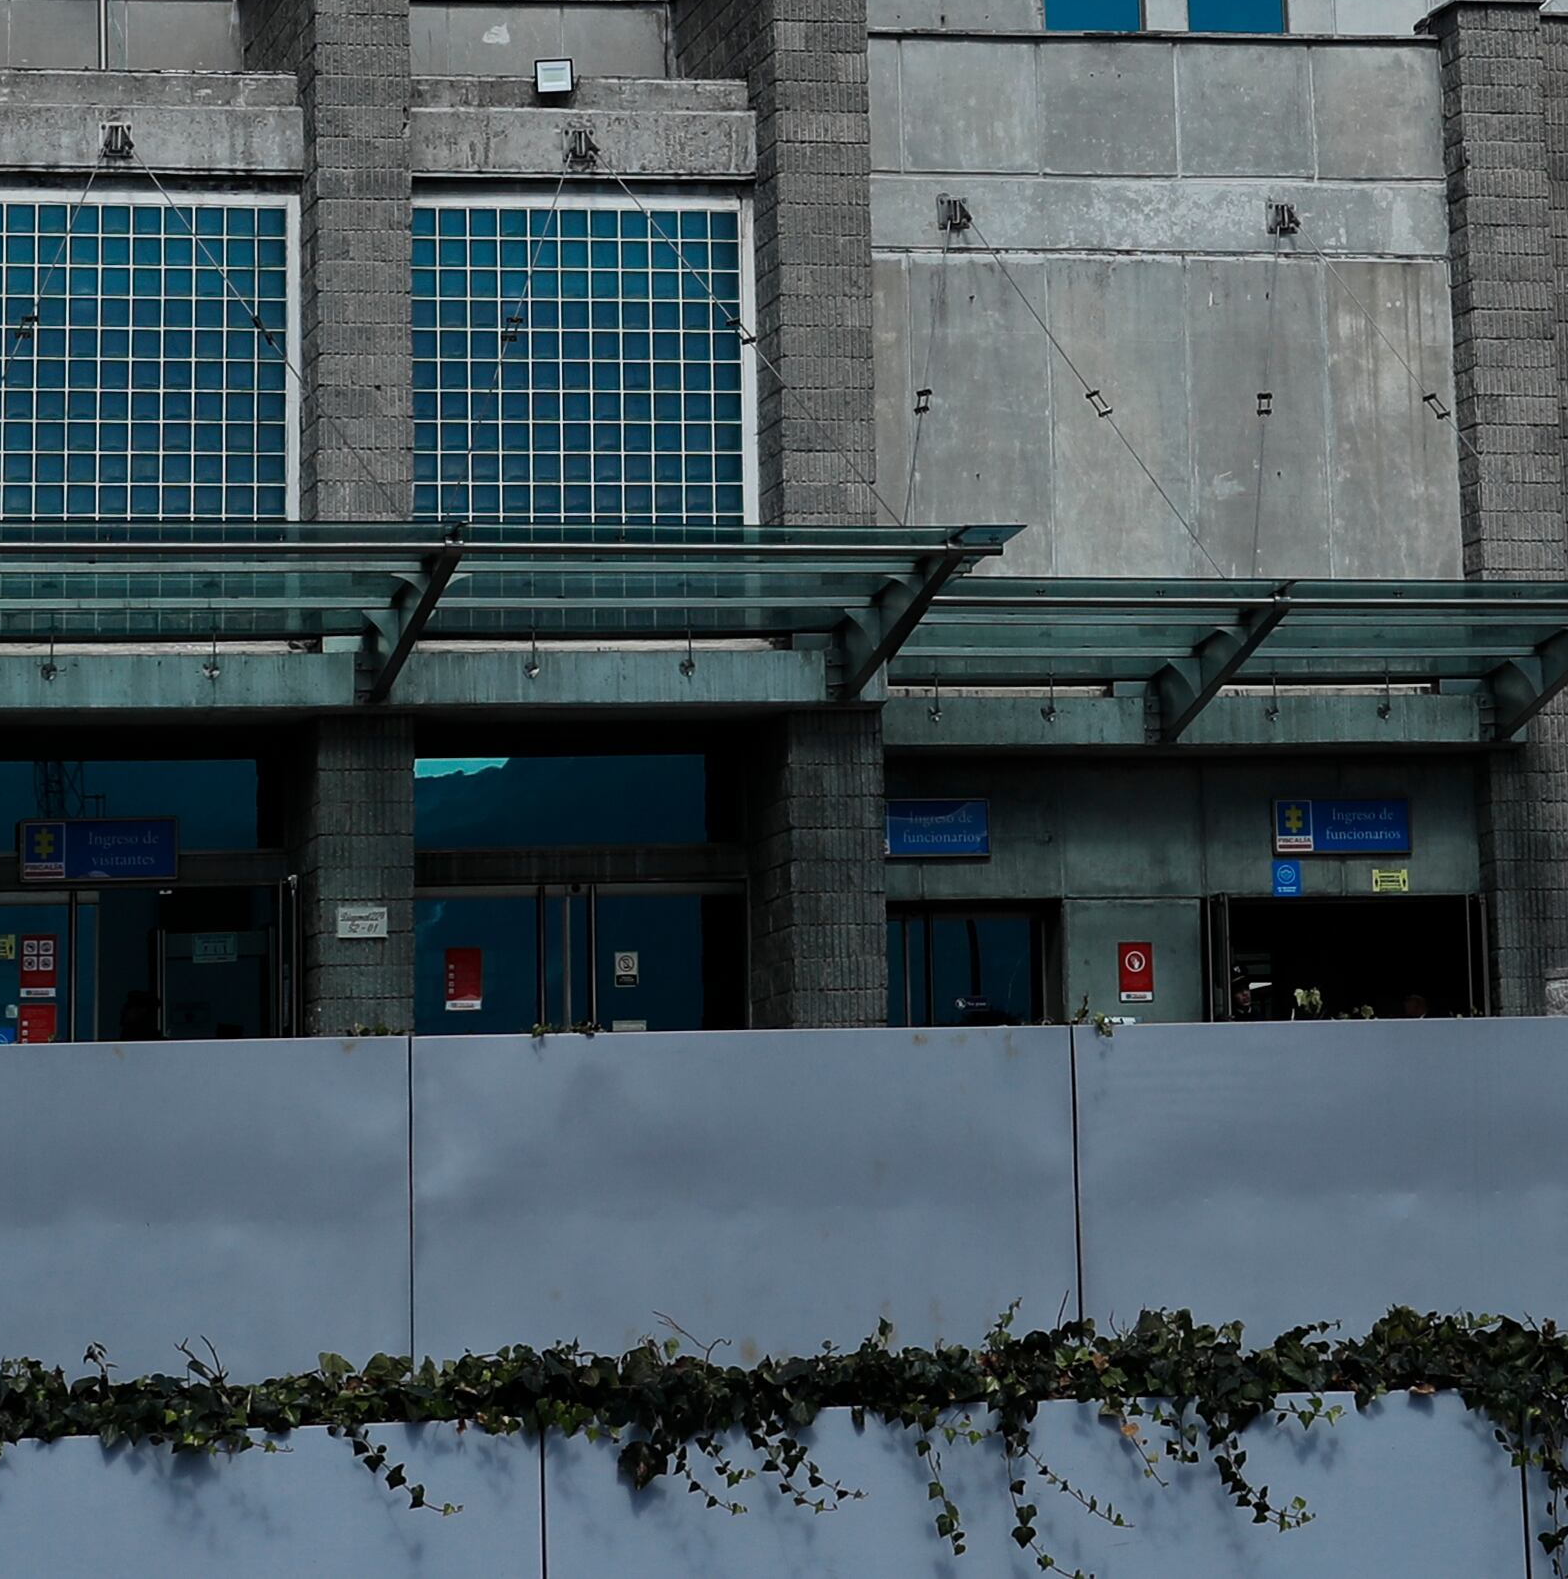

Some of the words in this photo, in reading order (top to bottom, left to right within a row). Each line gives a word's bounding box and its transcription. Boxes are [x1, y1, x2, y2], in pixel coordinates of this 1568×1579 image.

[910, 809, 954, 827] Ingreso
[958, 809, 974, 823] de
[1332, 806, 1376, 824] Ingreso
[1378, 806, 1395, 821] de
[88, 829, 138, 849] Ingreso
[142, 829, 160, 844] de
[903, 829, 982, 843] funcionarios
[1325, 825, 1402, 840] funcionarios
[91, 853, 156, 866] visitantes
